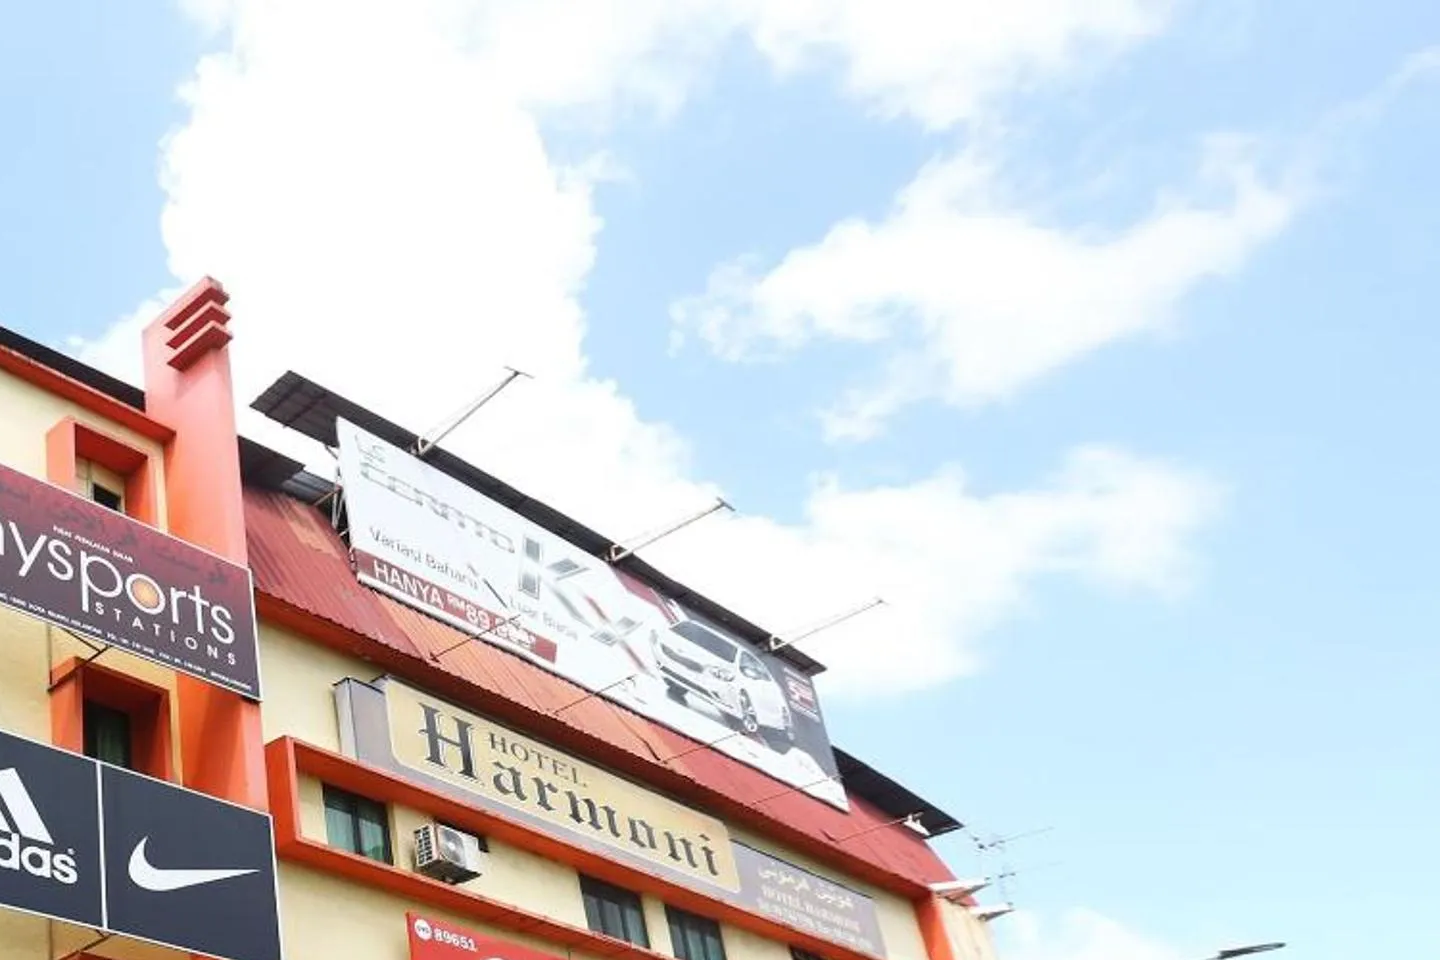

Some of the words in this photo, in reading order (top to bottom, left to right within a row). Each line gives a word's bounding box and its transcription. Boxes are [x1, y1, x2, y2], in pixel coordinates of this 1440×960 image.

[373, 558, 444, 611] HANYA
[93, 601, 237, 666] STATIONS
[419, 701, 724, 879] Harmoni
[488, 733, 588, 790] HOTEL
[434, 928, 478, 952] 89651
